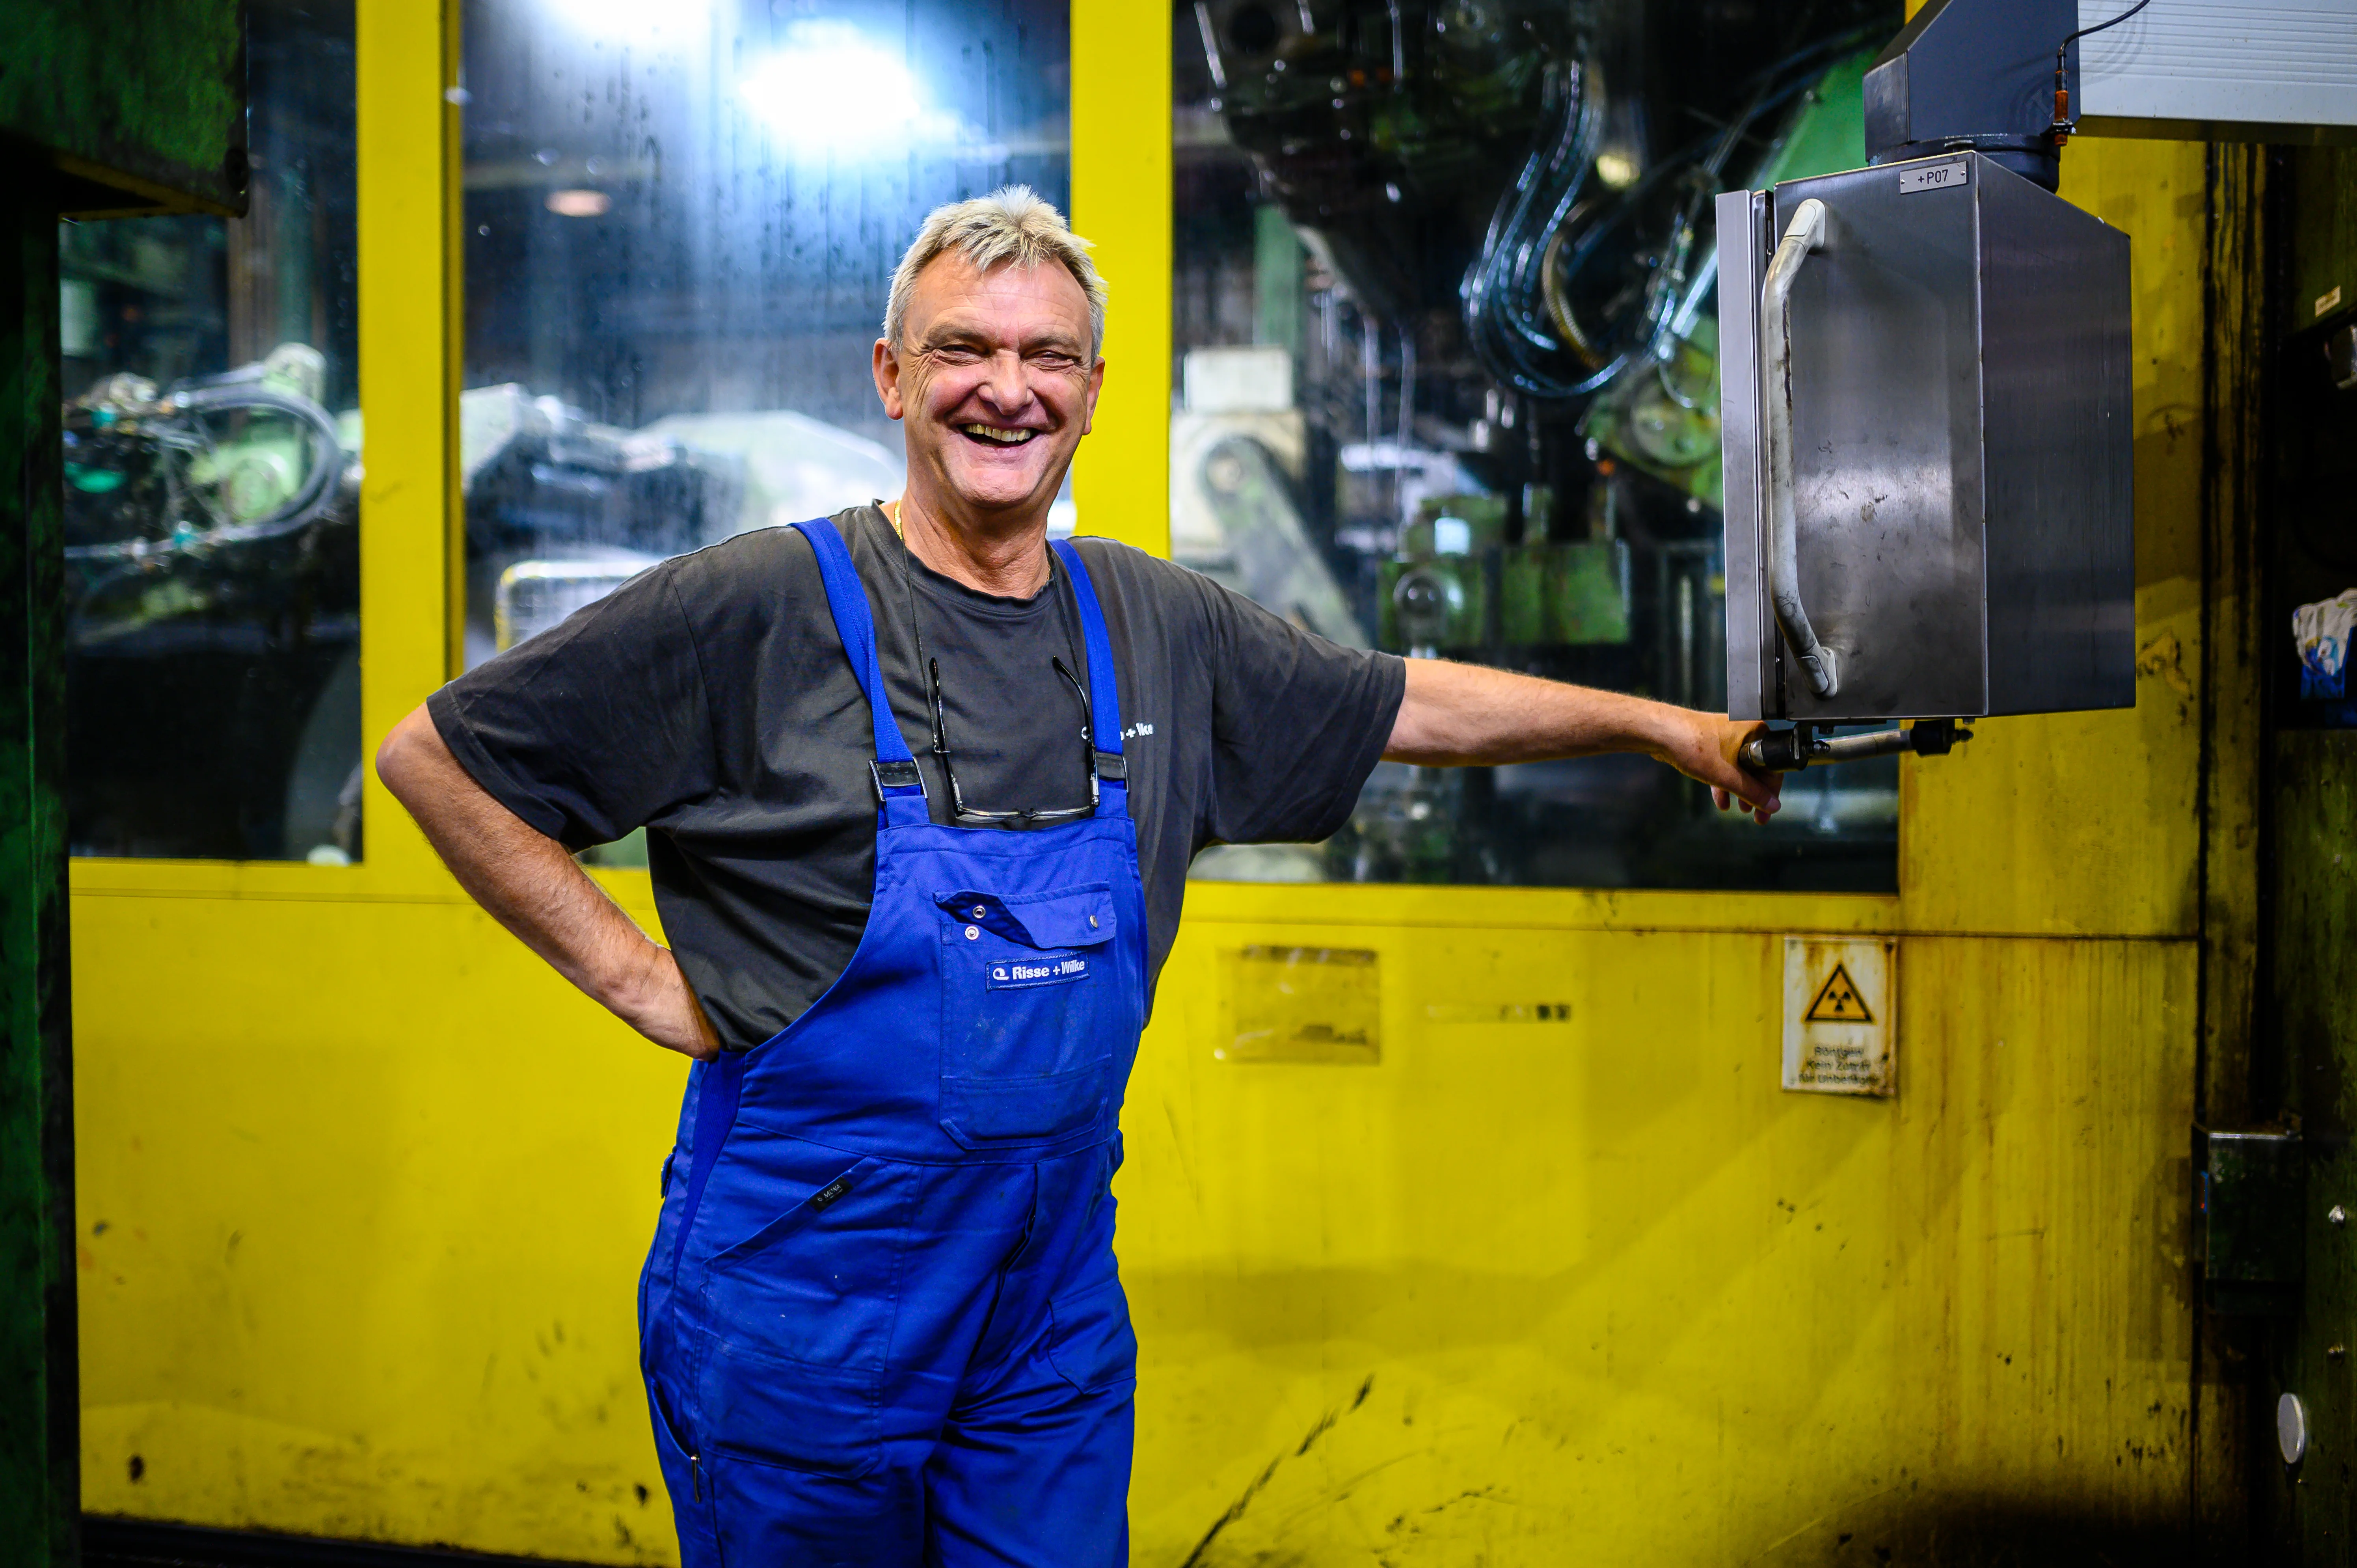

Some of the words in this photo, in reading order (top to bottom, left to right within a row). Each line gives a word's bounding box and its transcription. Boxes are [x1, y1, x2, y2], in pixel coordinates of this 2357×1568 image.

[1918, 169, 1948, 184] +P07
[1012, 966, 1050, 980] Risse
[1052, 966, 1060, 975] +
[1061, 960, 1085, 975] Wilke
[1817, 1073, 1879, 1085] Unbefug
[823, 1184, 842, 1199] MEWA
